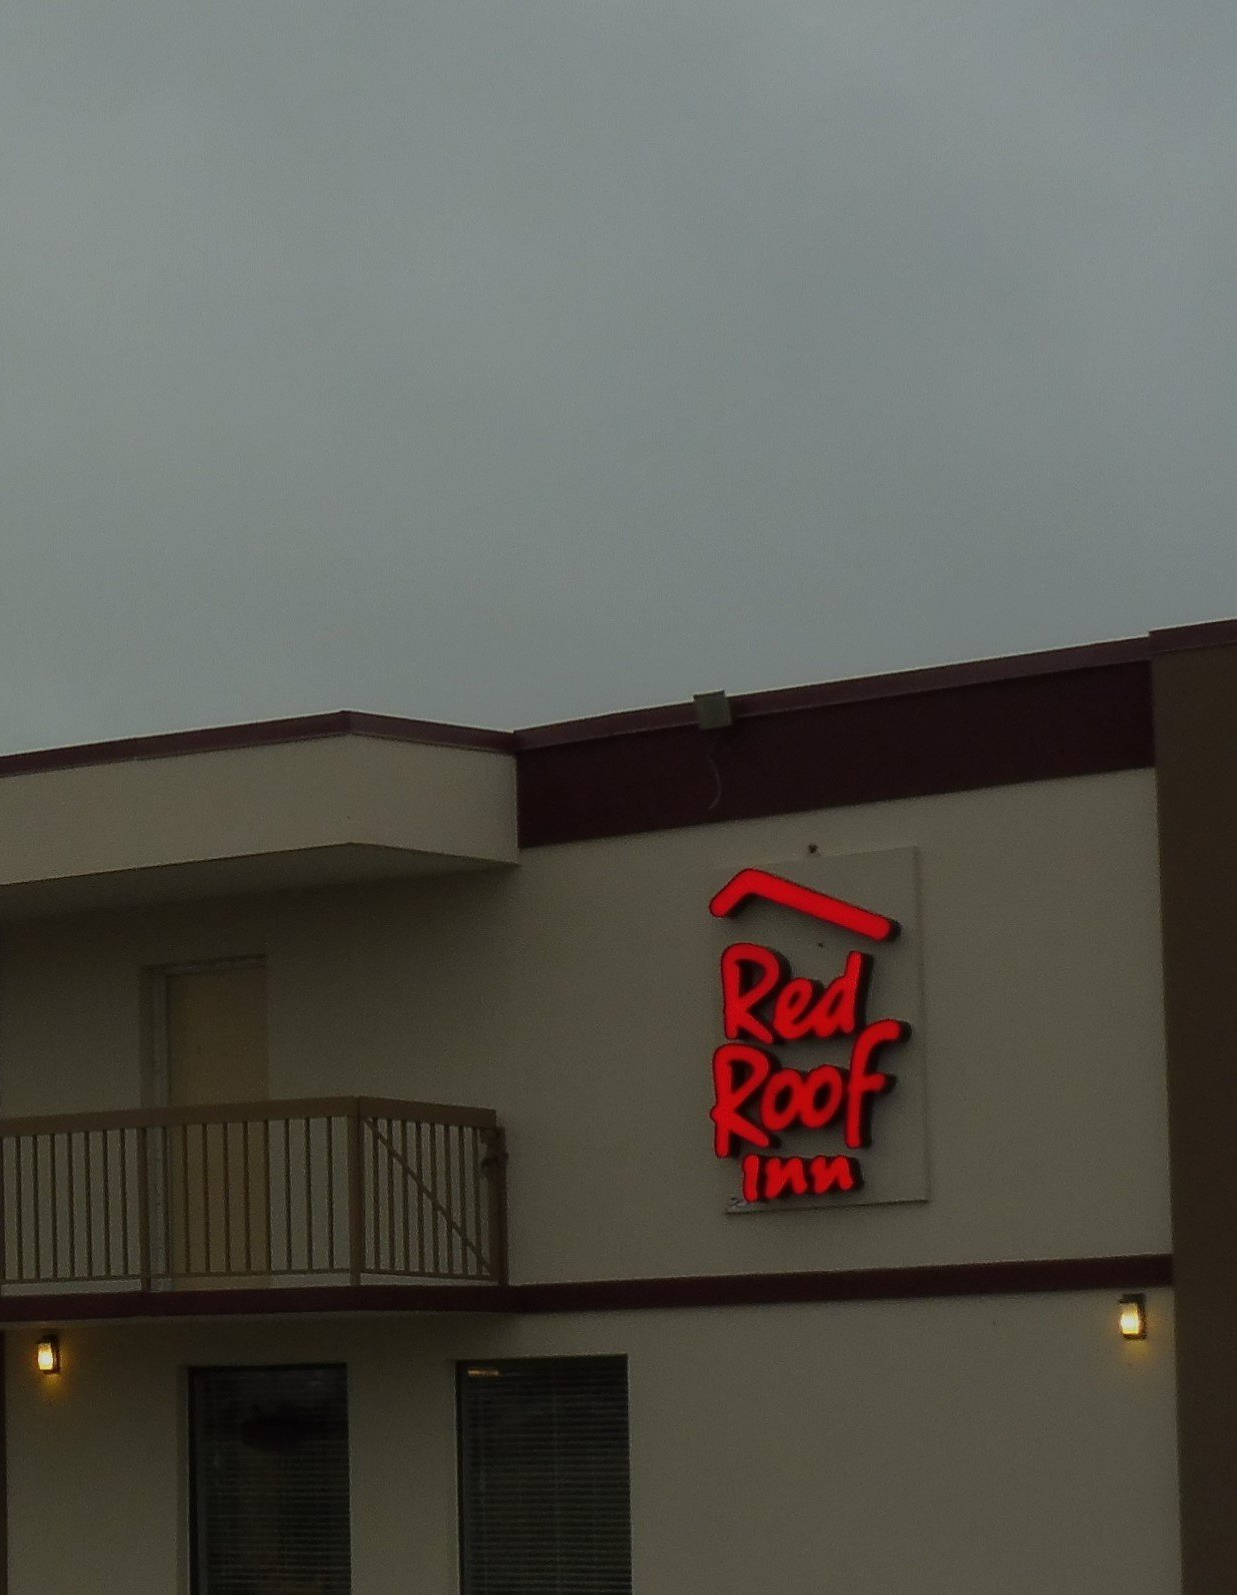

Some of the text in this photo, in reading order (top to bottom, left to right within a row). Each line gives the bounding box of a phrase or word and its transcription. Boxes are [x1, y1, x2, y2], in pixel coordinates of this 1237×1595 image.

[722, 942, 864, 1043] Red
[711, 1019, 903, 1157] Roof
[743, 1153, 854, 1202] Inn
